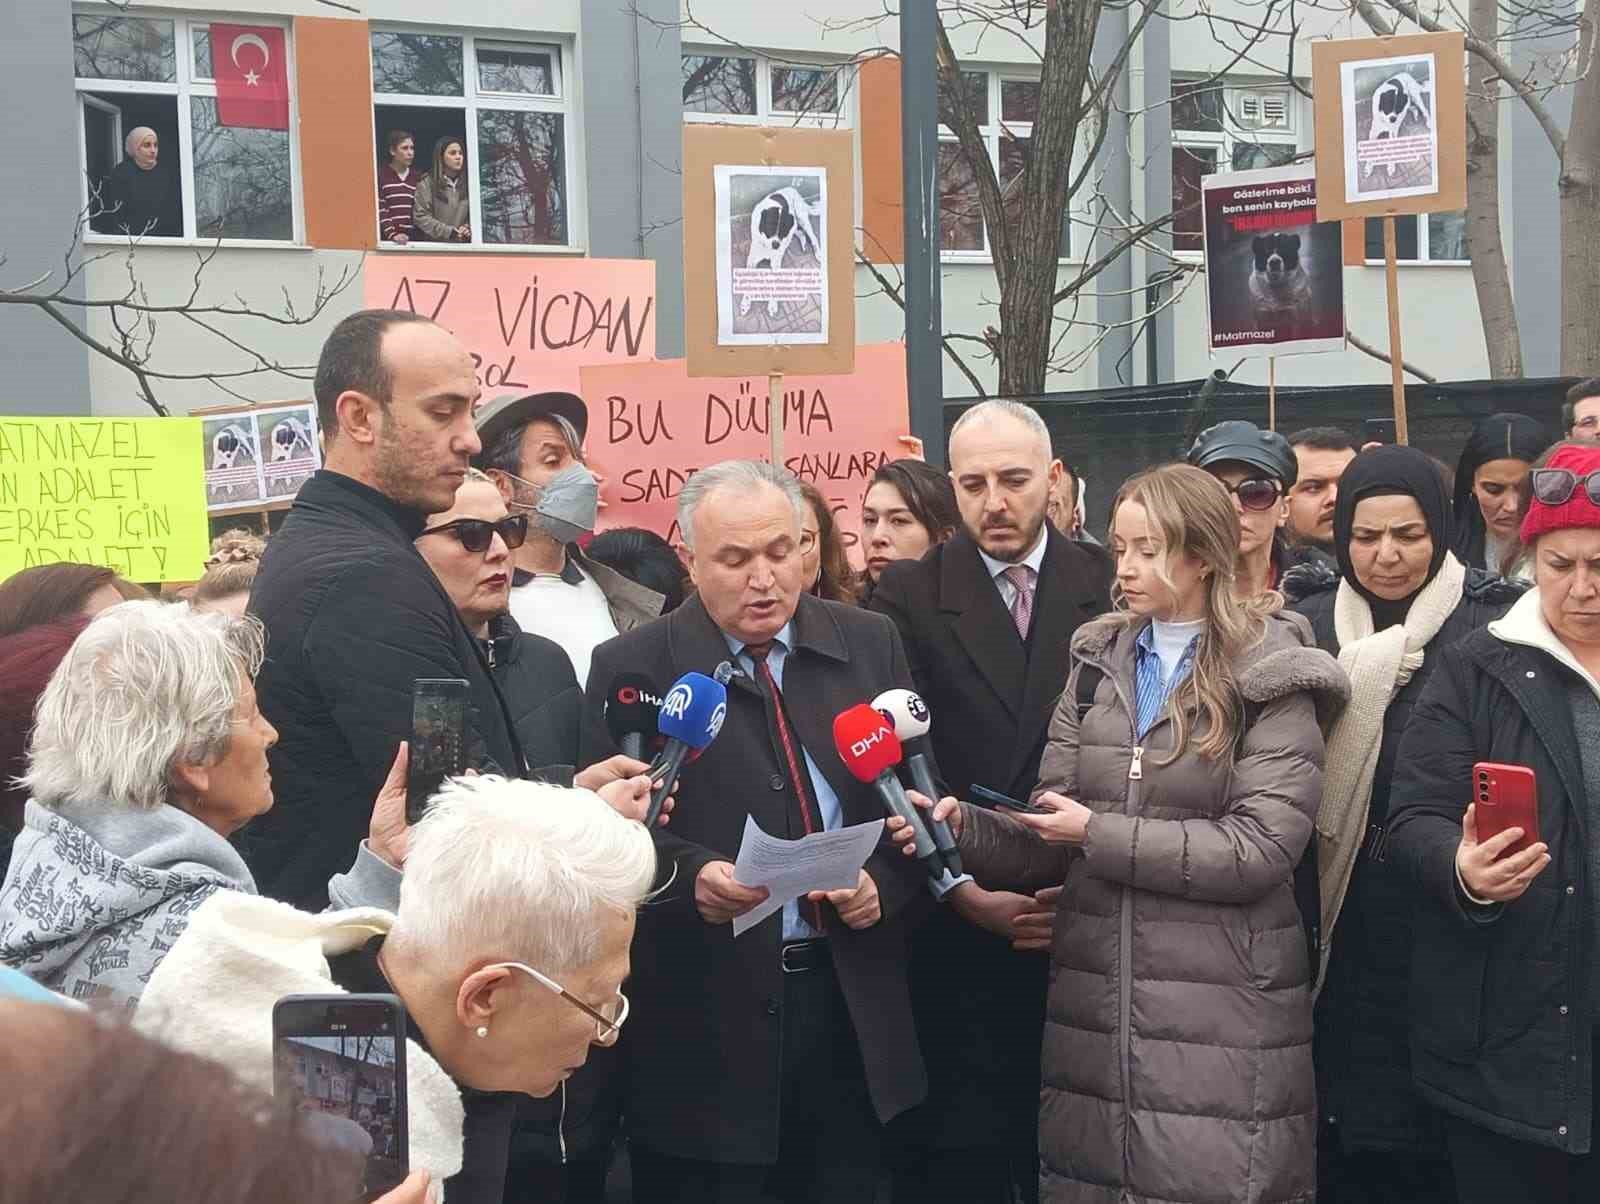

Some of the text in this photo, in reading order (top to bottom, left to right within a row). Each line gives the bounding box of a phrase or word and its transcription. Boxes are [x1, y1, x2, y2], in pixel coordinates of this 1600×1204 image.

[1222, 204, 1243, 214] ben
[1244, 201, 1272, 213] senin
[1233, 183, 1312, 200] Gözlerime bak!
[494, 275, 653, 357] VİCDAN
[1214, 328, 1276, 341] #Matmazel
[608, 395, 674, 445] BU
[39, 467, 153, 505] ADALET
[620, 466, 699, 503] SAD
[118, 502, 172, 542] İÇİN
[850, 726, 892, 758] DHA
